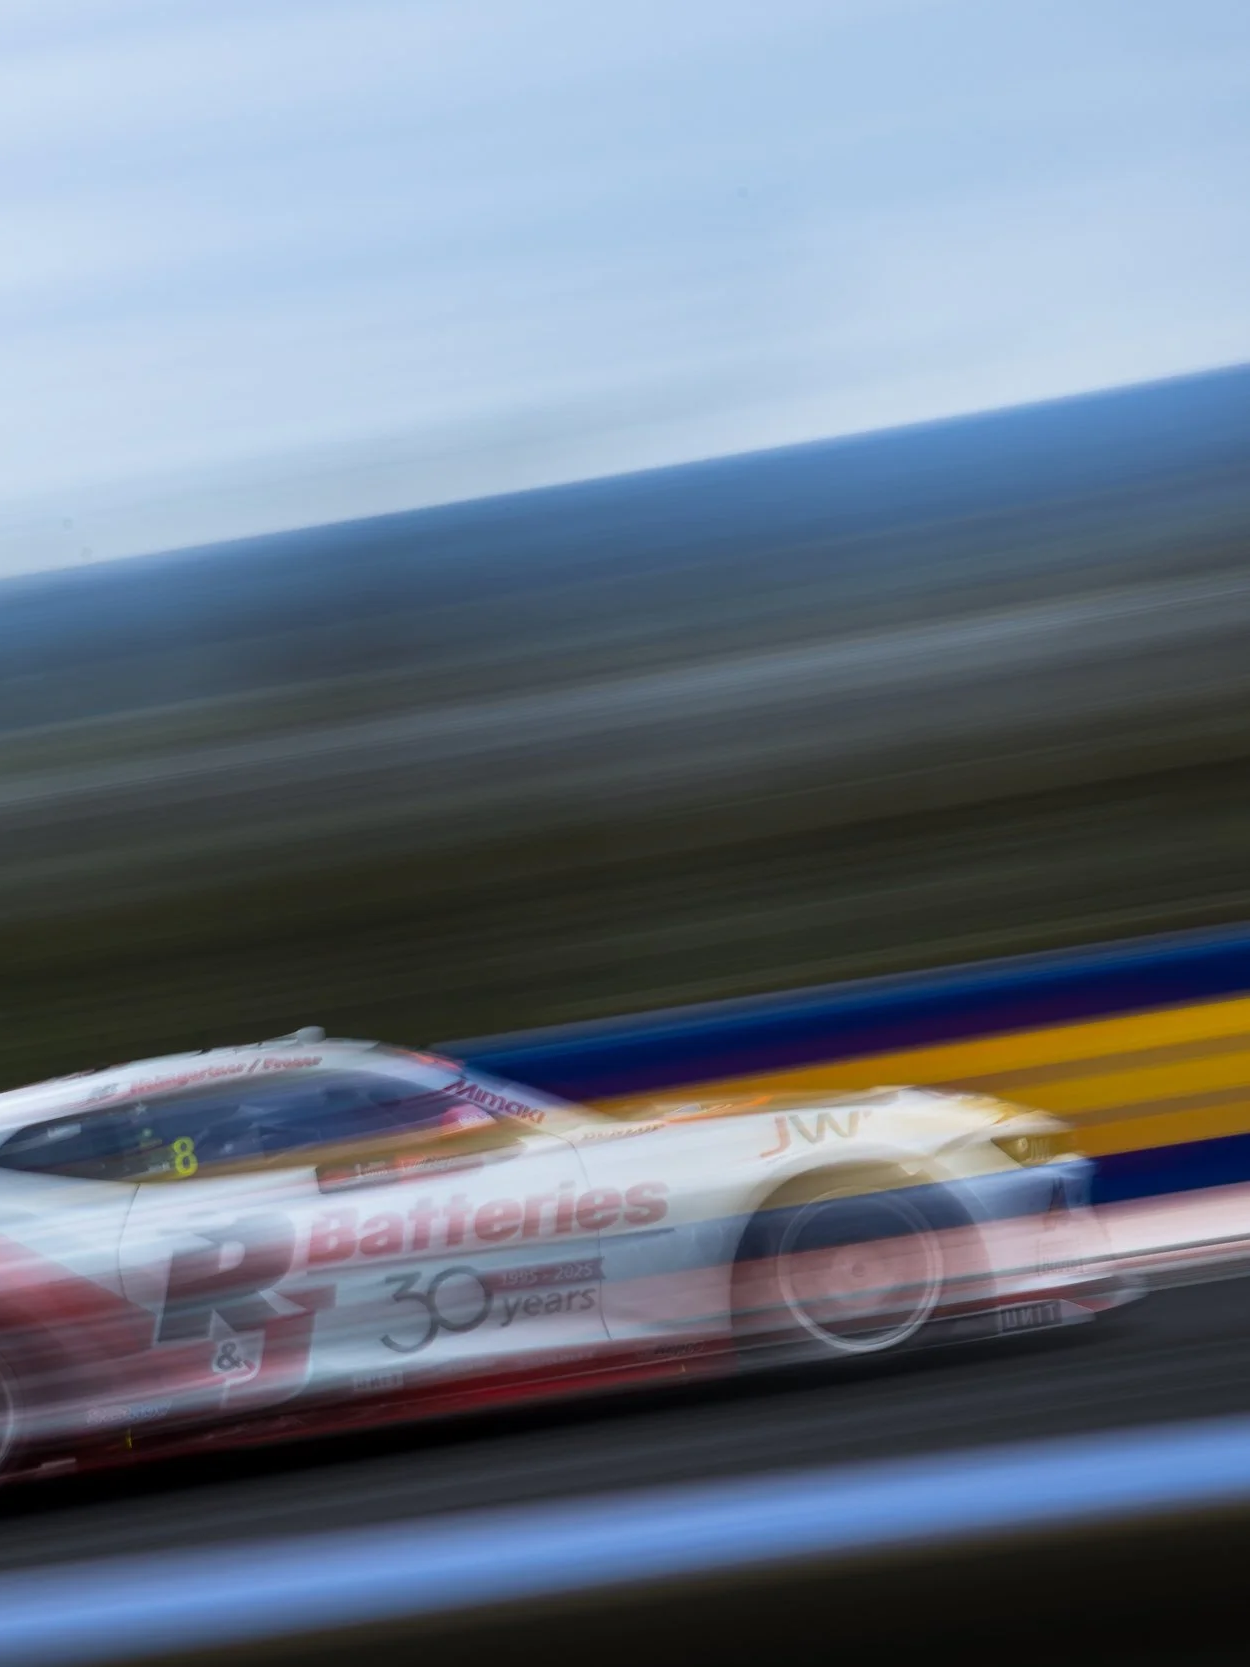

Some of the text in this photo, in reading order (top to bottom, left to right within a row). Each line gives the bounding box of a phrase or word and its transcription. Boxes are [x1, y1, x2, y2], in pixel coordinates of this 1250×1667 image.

[442, 1078, 546, 1125] Mimaki
[173, 1136, 198, 1177] 8
[307, 1179, 670, 1266] Batteries
[554, 1261, 595, 1281] 2025
[380, 1264, 493, 1353] 30
[500, 1286, 597, 1327] years
[215, 1341, 246, 1371] &
